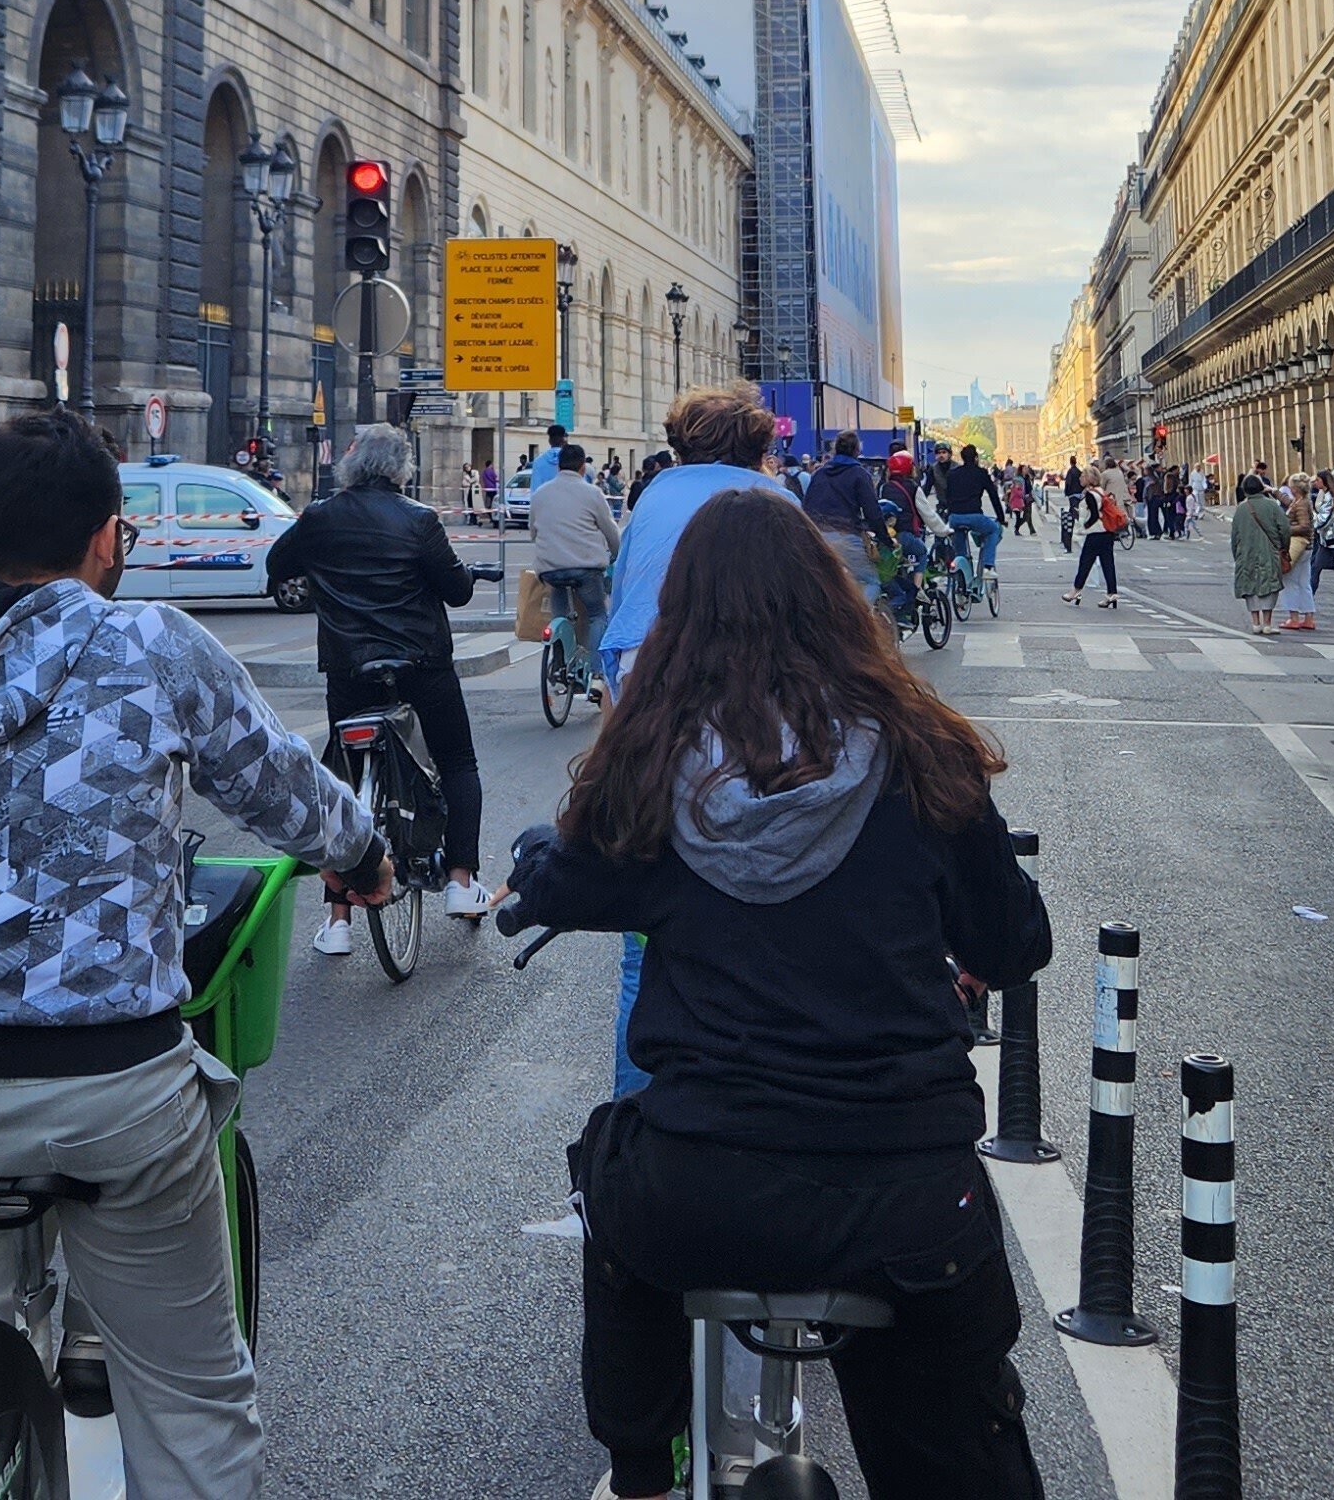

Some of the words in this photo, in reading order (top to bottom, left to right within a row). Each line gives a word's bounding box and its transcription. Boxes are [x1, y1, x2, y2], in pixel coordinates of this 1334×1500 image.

[460, 265, 481, 273] PLACE
[484, 265, 492, 273] DE
[494, 265, 503, 273] LA
